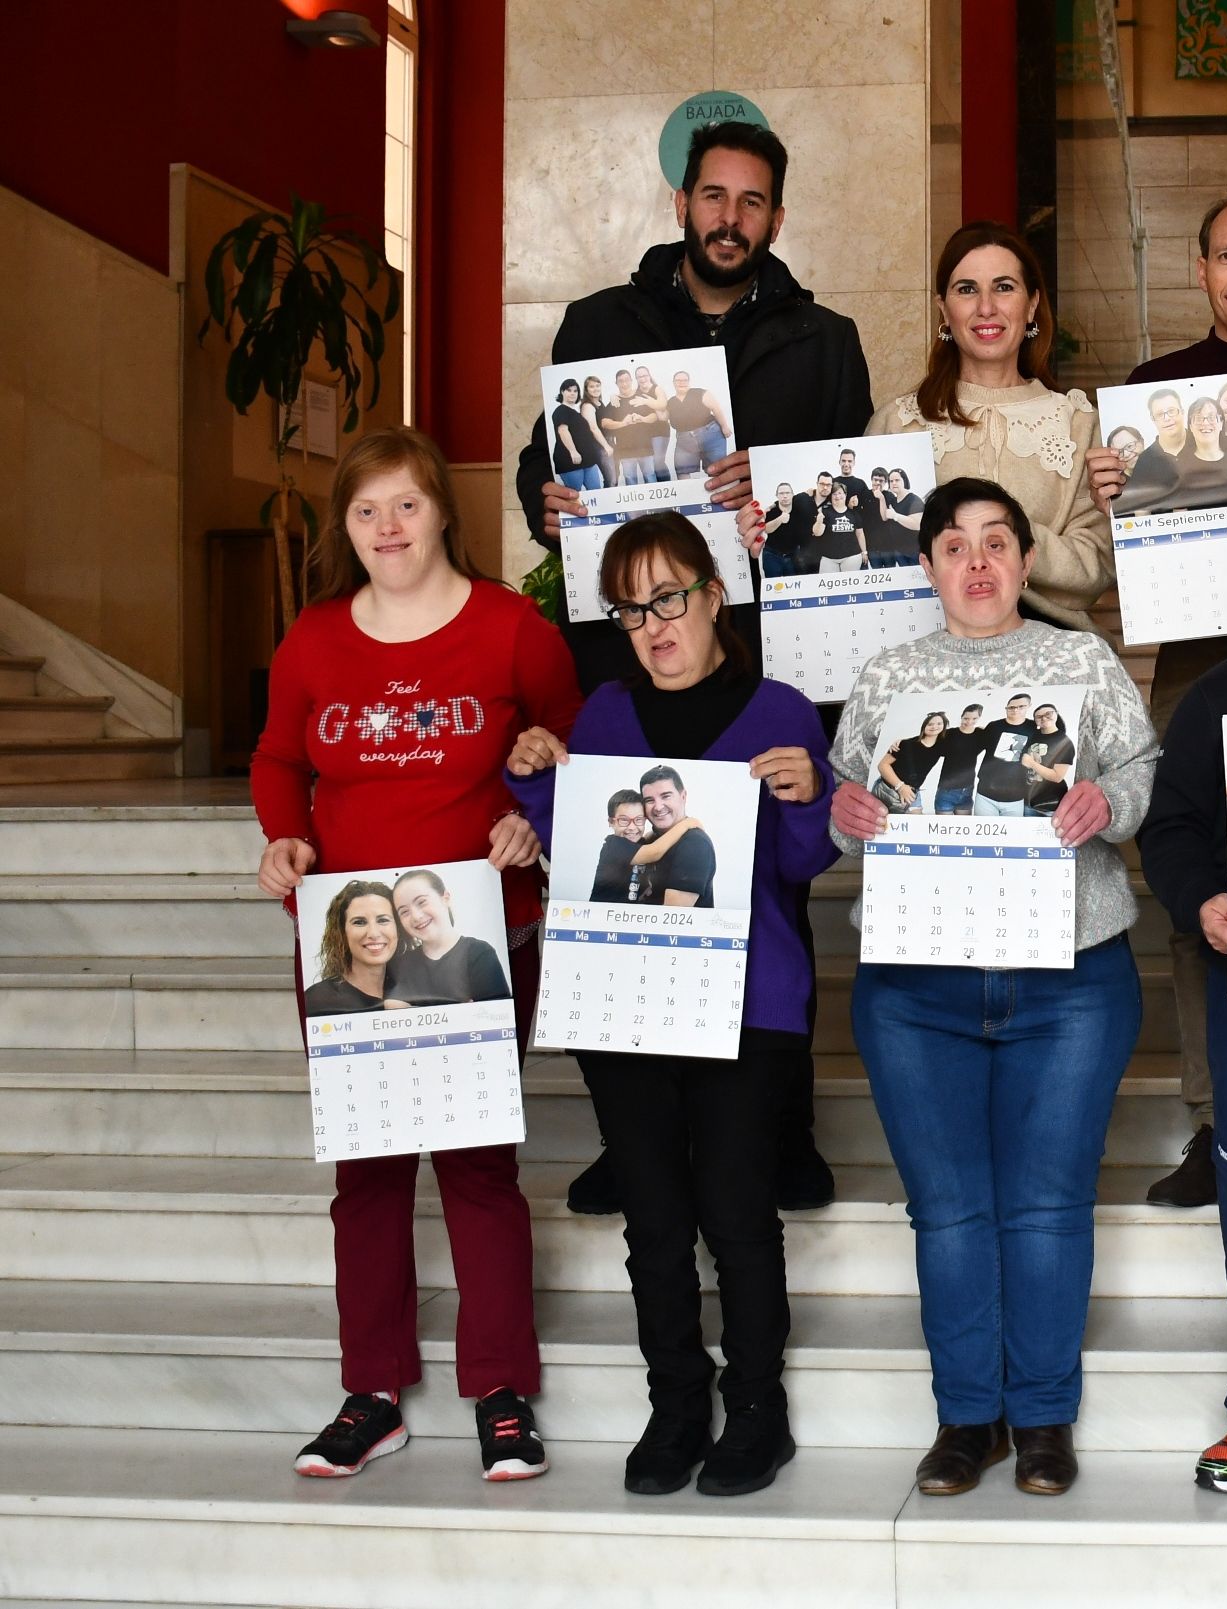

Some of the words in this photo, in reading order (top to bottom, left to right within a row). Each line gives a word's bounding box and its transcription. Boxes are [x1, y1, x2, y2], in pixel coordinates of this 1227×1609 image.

[687, 105, 745, 119] BAJADA
[580, 498, 597, 507] WN
[616, 491, 644, 504] Julio
[650, 488, 677, 500] 2024
[702, 504, 712, 512] Sa
[1158, 512, 1225, 527] Septiembre
[566, 554, 572, 562] 8
[566, 572, 575, 580] 15
[818, 578, 859, 589] Agosto
[864, 574, 892, 585] 2024
[568, 590, 578, 599] 22
[570, 608, 580, 617] 29
[766, 636, 771, 645] 5
[795, 634, 801, 642] 6
[824, 631, 829, 639] 7
[765, 654, 773, 662] 12
[795, 651, 803, 660] 13
[823, 649, 832, 657] 14
[385, 680, 421, 694] Feel
[360, 745, 445, 767] everyday
[928, 823, 970, 835] Marzo
[976, 824, 1007, 836] 2024
[865, 844, 876, 853] Lu
[896, 845, 910, 853] Ma
[929, 846, 940, 854] Mi
[962, 847, 972, 855] Ju
[994, 848, 1003, 856] Vi
[1027, 848, 1039, 857] Sa
[1060, 849, 1073, 857] Do
[866, 884, 873, 892] 4
[900, 884, 906, 894] 5
[934, 885, 940, 895] 6
[967, 885, 973, 896] 7
[999, 887, 1005, 897] 8
[1031, 888, 1037, 898] 9
[1062, 889, 1072, 899] 10
[606, 910, 658, 924] Febrero
[663, 913, 693, 925] 2024
[546, 930, 556, 939] Lu
[607, 933, 618, 942] Mi
[638, 935, 649, 944] Ju
[670, 937, 678, 945] Vi
[701, 938, 712, 947] Sa
[732, 939, 744, 949] Do
[572, 991, 582, 1001] 13
[605, 993, 614, 1002] 14
[637, 994, 646, 1005] 15
[667, 996, 675, 1006] 16
[698, 998, 708, 1008] 17
[731, 1000, 740, 1010] 18
[372, 1016, 412, 1030] Enero
[417, 1013, 449, 1026] 2024
[309, 1046, 321, 1056] Lu
[341, 1044, 355, 1053] Ma
[374, 1041, 384, 1050] Mi
[406, 1038, 417, 1047] Ju
[438, 1035, 447, 1045] Vi
[470, 1032, 482, 1041] Sa
[502, 1029, 515, 1038] Do
[314, 1087, 321, 1097] 8
[347, 1083, 353, 1093] 9
[378, 1080, 388, 1090] 10
[412, 1077, 420, 1087] 11
[442, 1074, 452, 1084] 12
[476, 1071, 486, 1081] 13
